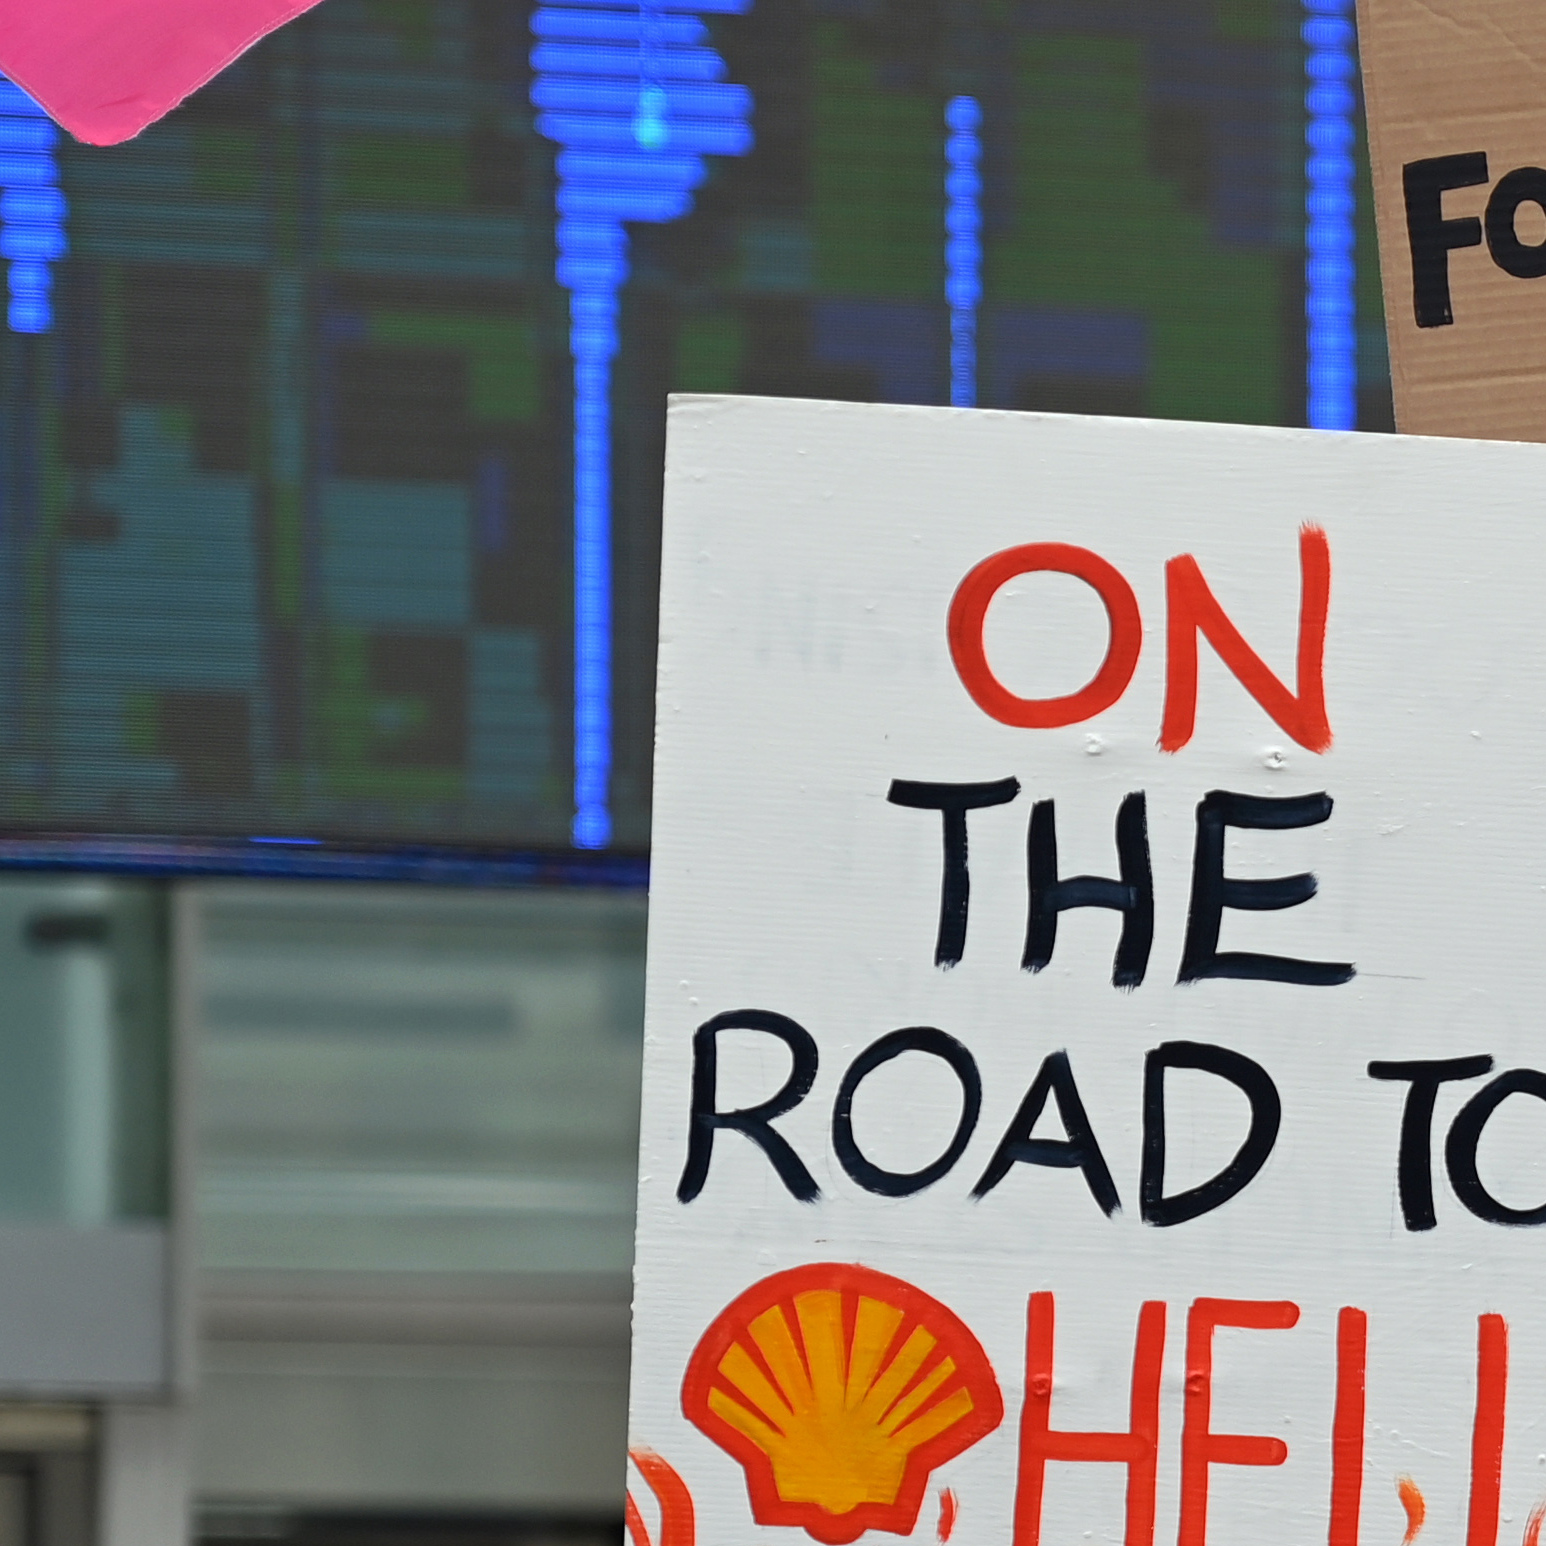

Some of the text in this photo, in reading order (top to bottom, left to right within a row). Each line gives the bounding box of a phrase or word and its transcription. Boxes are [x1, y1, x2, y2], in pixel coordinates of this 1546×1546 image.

[947, 520, 1332, 754] ON
[886, 775, 1357, 992] THE
[677, 1007, 1282, 1226] ROAD
